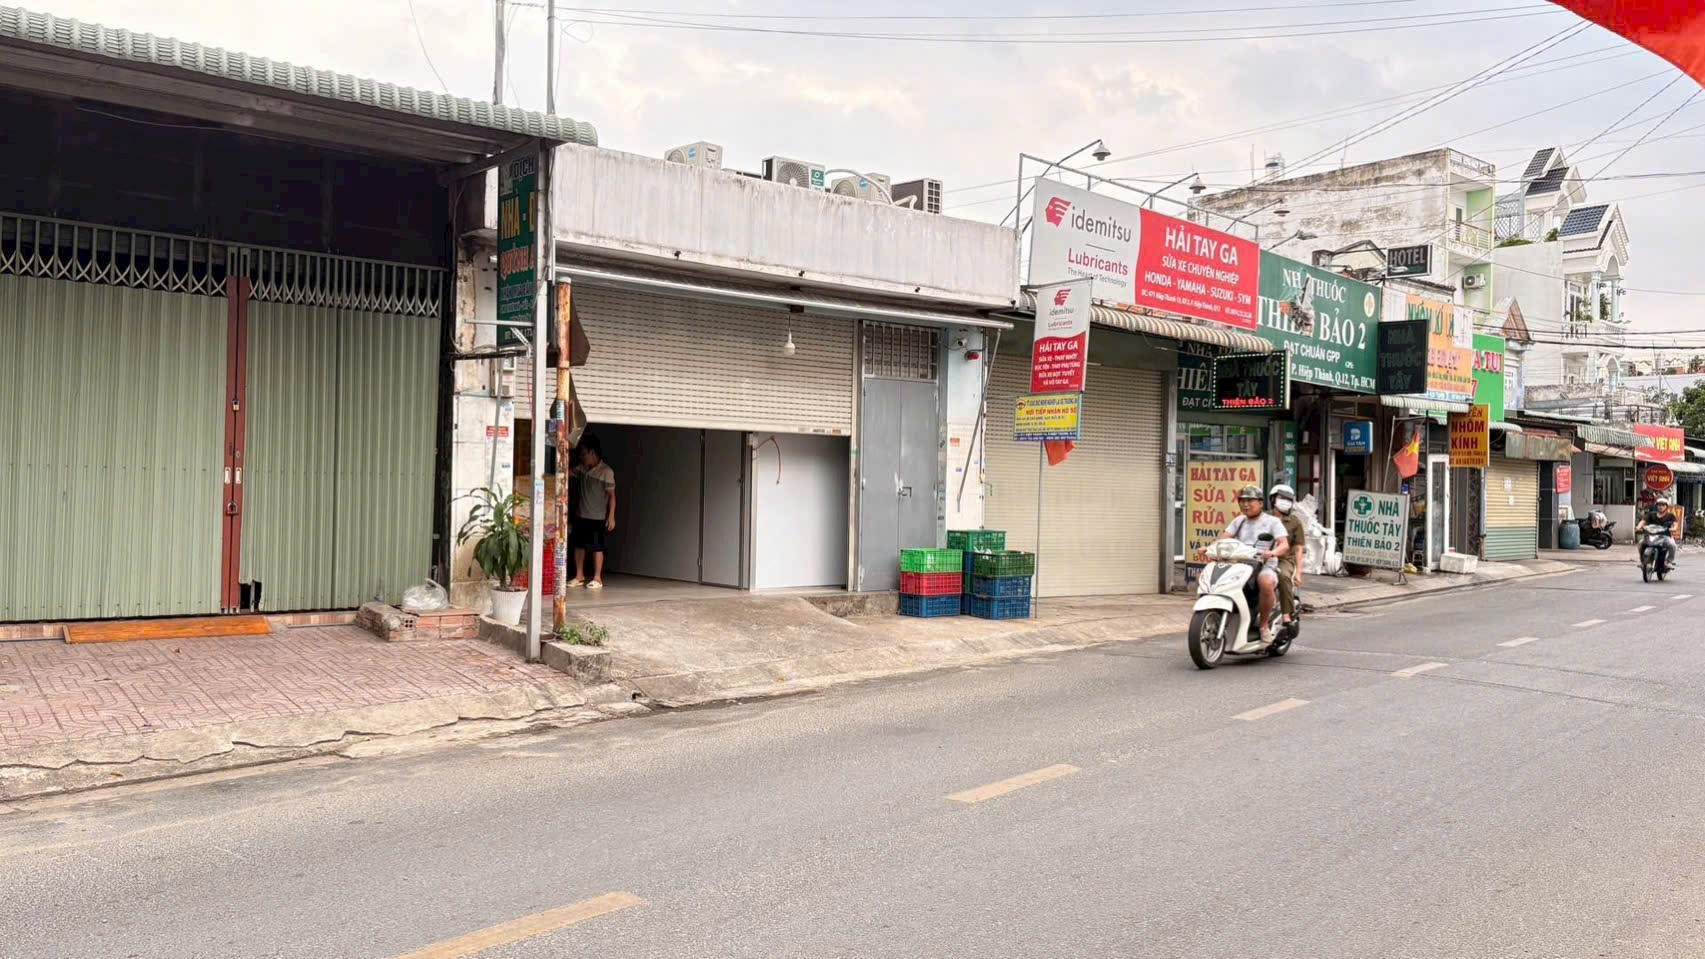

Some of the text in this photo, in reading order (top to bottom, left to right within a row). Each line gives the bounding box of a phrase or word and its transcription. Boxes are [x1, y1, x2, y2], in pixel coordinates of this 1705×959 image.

[1071, 206, 1131, 242] idemitsu
[1165, 225, 1239, 266] HẢI TAY GA
[1068, 247, 1128, 276] Lubricants
[1178, 260, 1187, 272] XE
[1390, 247, 1426, 267] HOTEL
[1144, 270, 1172, 287] HONDA
[1177, 278, 1206, 295] YAMAHA
[1210, 286, 1234, 301] SUZUKI
[1237, 293, 1252, 305] SYM
[1306, 273, 1347, 304] THUỐC
[1319, 307, 1355, 347] BẢO
[1357, 322, 1367, 350] 2
[1053, 341, 1067, 352] TAY
[1067, 340, 1079, 350] GA
[1326, 349, 1341, 363] GPP
[1235, 378, 1259, 396] TÂY
[1360, 377, 1376, 390] HCM
[1451, 418, 1484, 432] NHÔM
[1451, 434, 1478, 449] KÍNH
[1191, 463, 1256, 481] HẢI TAY GA
[1193, 484, 1225, 502] SỬA
[1192, 506, 1225, 524] RỬA
[1378, 497, 1399, 516] NHÀ
[1195, 528, 1220, 537] THAY
[1349, 516, 1401, 537] THUỐC TÂY
[1347, 535, 1400, 551] THIÊN BẢO 2
